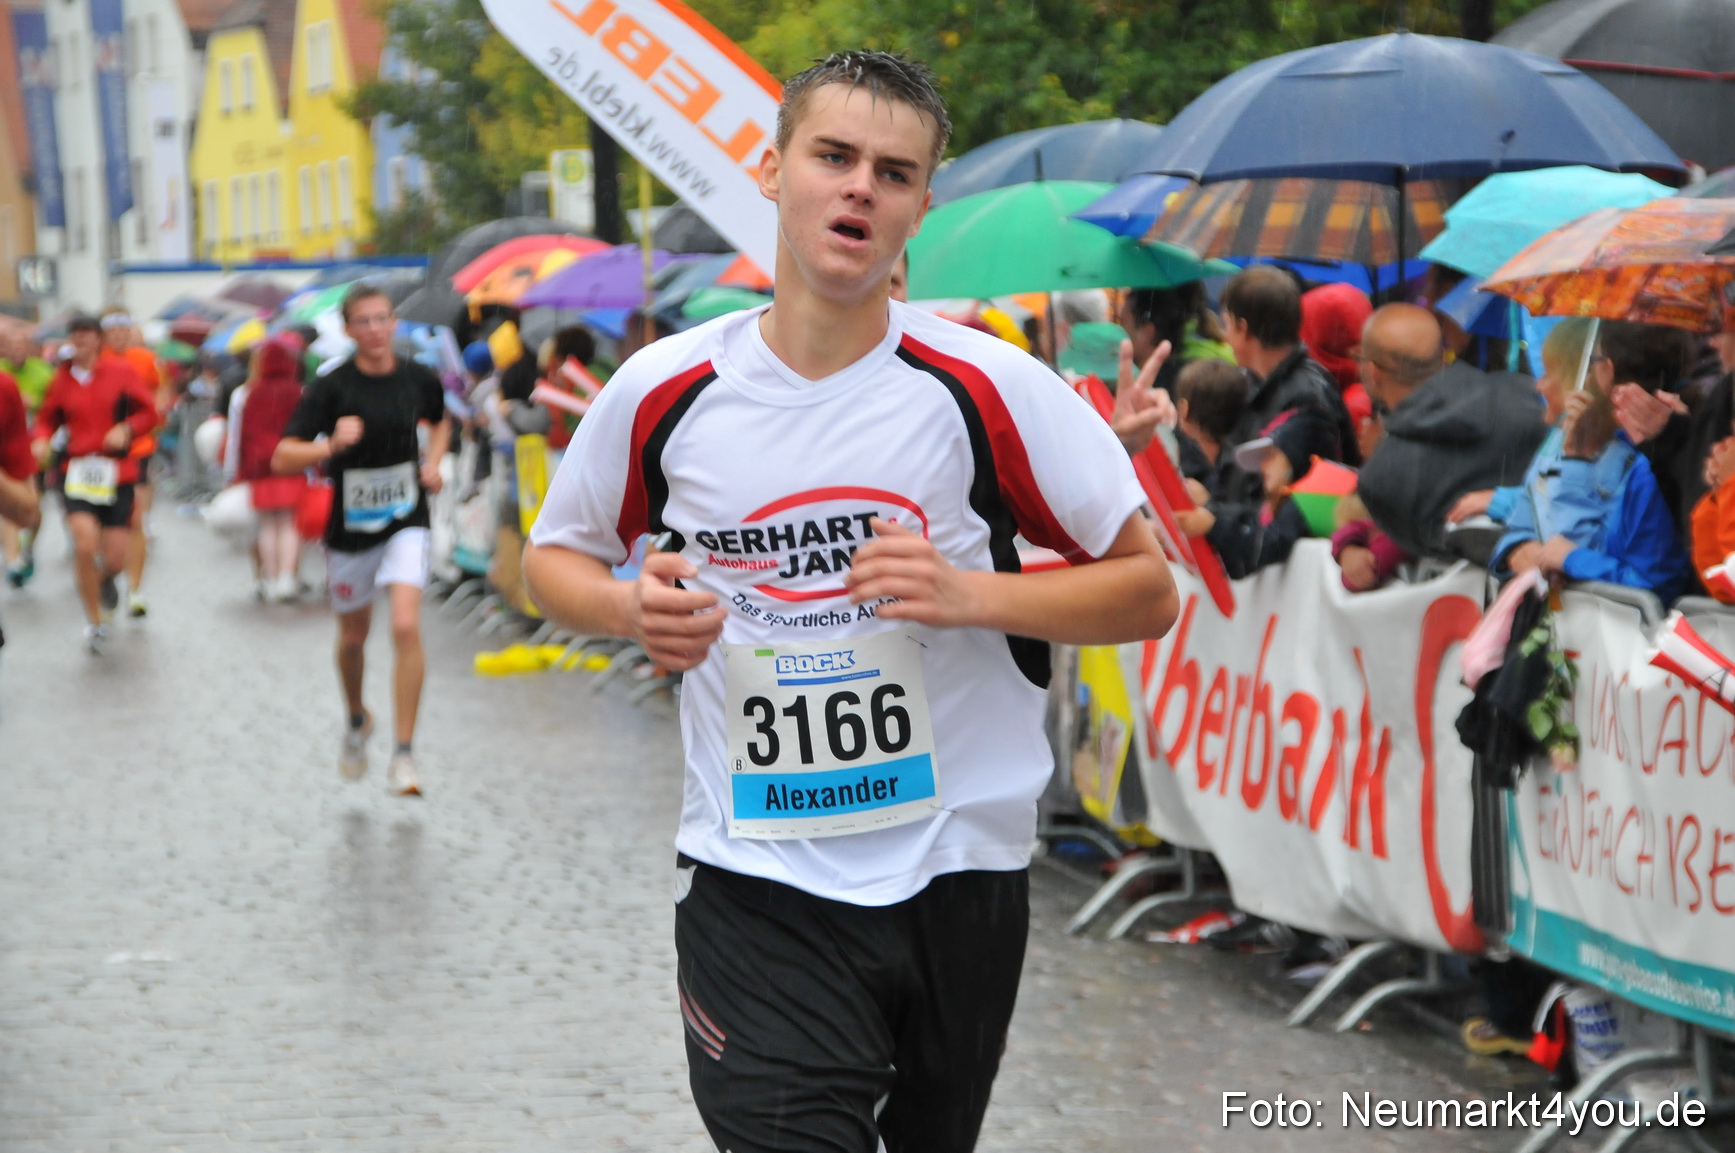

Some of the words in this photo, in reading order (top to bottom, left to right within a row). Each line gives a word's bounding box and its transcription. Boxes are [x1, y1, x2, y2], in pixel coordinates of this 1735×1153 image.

[695, 511, 879, 554] GERHART
[708, 552, 779, 570] Autohaus
[732, 592, 762, 617] Das
[762, 609, 852, 627] sportliche
[775, 649, 856, 674] BOCK
[743, 683, 912, 767] 3166
[765, 776, 899, 811] Alexander
